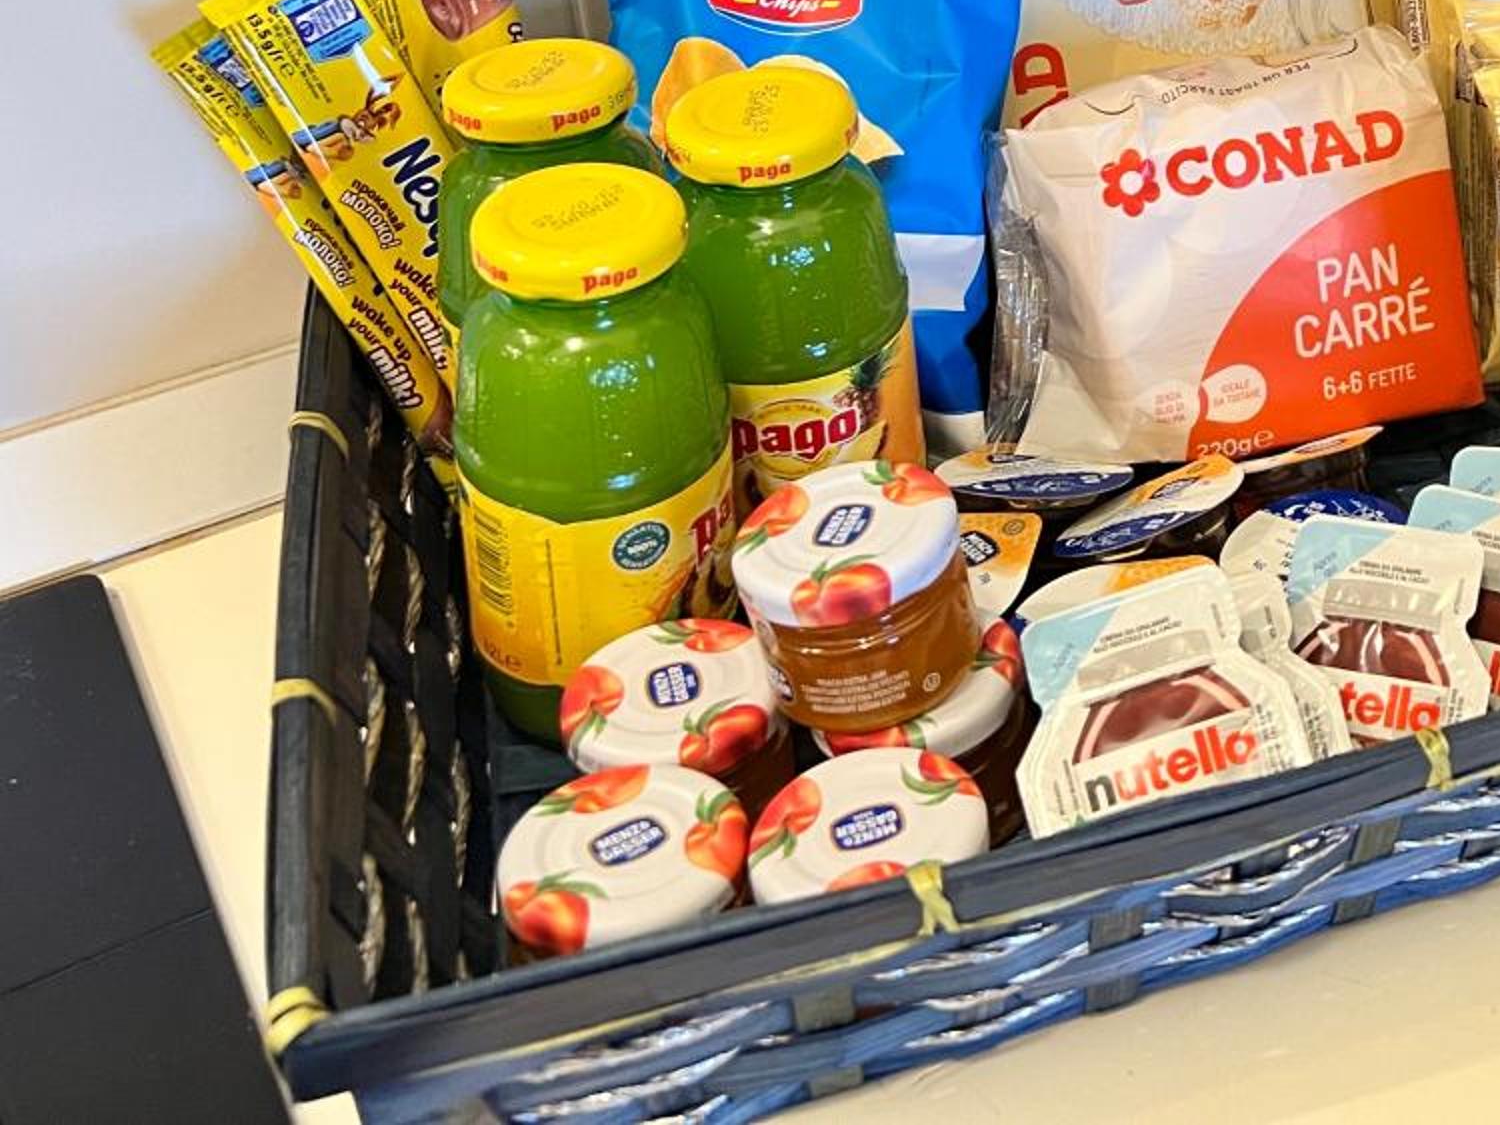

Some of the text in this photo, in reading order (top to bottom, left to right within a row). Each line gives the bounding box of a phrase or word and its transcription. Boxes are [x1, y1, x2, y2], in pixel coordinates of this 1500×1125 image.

[551, 105, 601, 132] pago
[738, 161, 791, 181] pago
[1166, 109, 1404, 197] CONAD
[390, 278, 427, 307] your
[394, 258, 438, 300] wake
[582, 267, 638, 294] pago
[1318, 243, 1399, 304] PAN
[350, 317, 382, 349] your
[351, 296, 412, 362] wake up
[1294, 276, 1435, 359] CARRÉ
[369, 346, 424, 410] milk!
[1322, 363, 1417, 400] 6+6 FETTE
[731, 408, 859, 461] pago
[1339, 679, 1441, 732] tella
[1084, 725, 1259, 812] nutella
